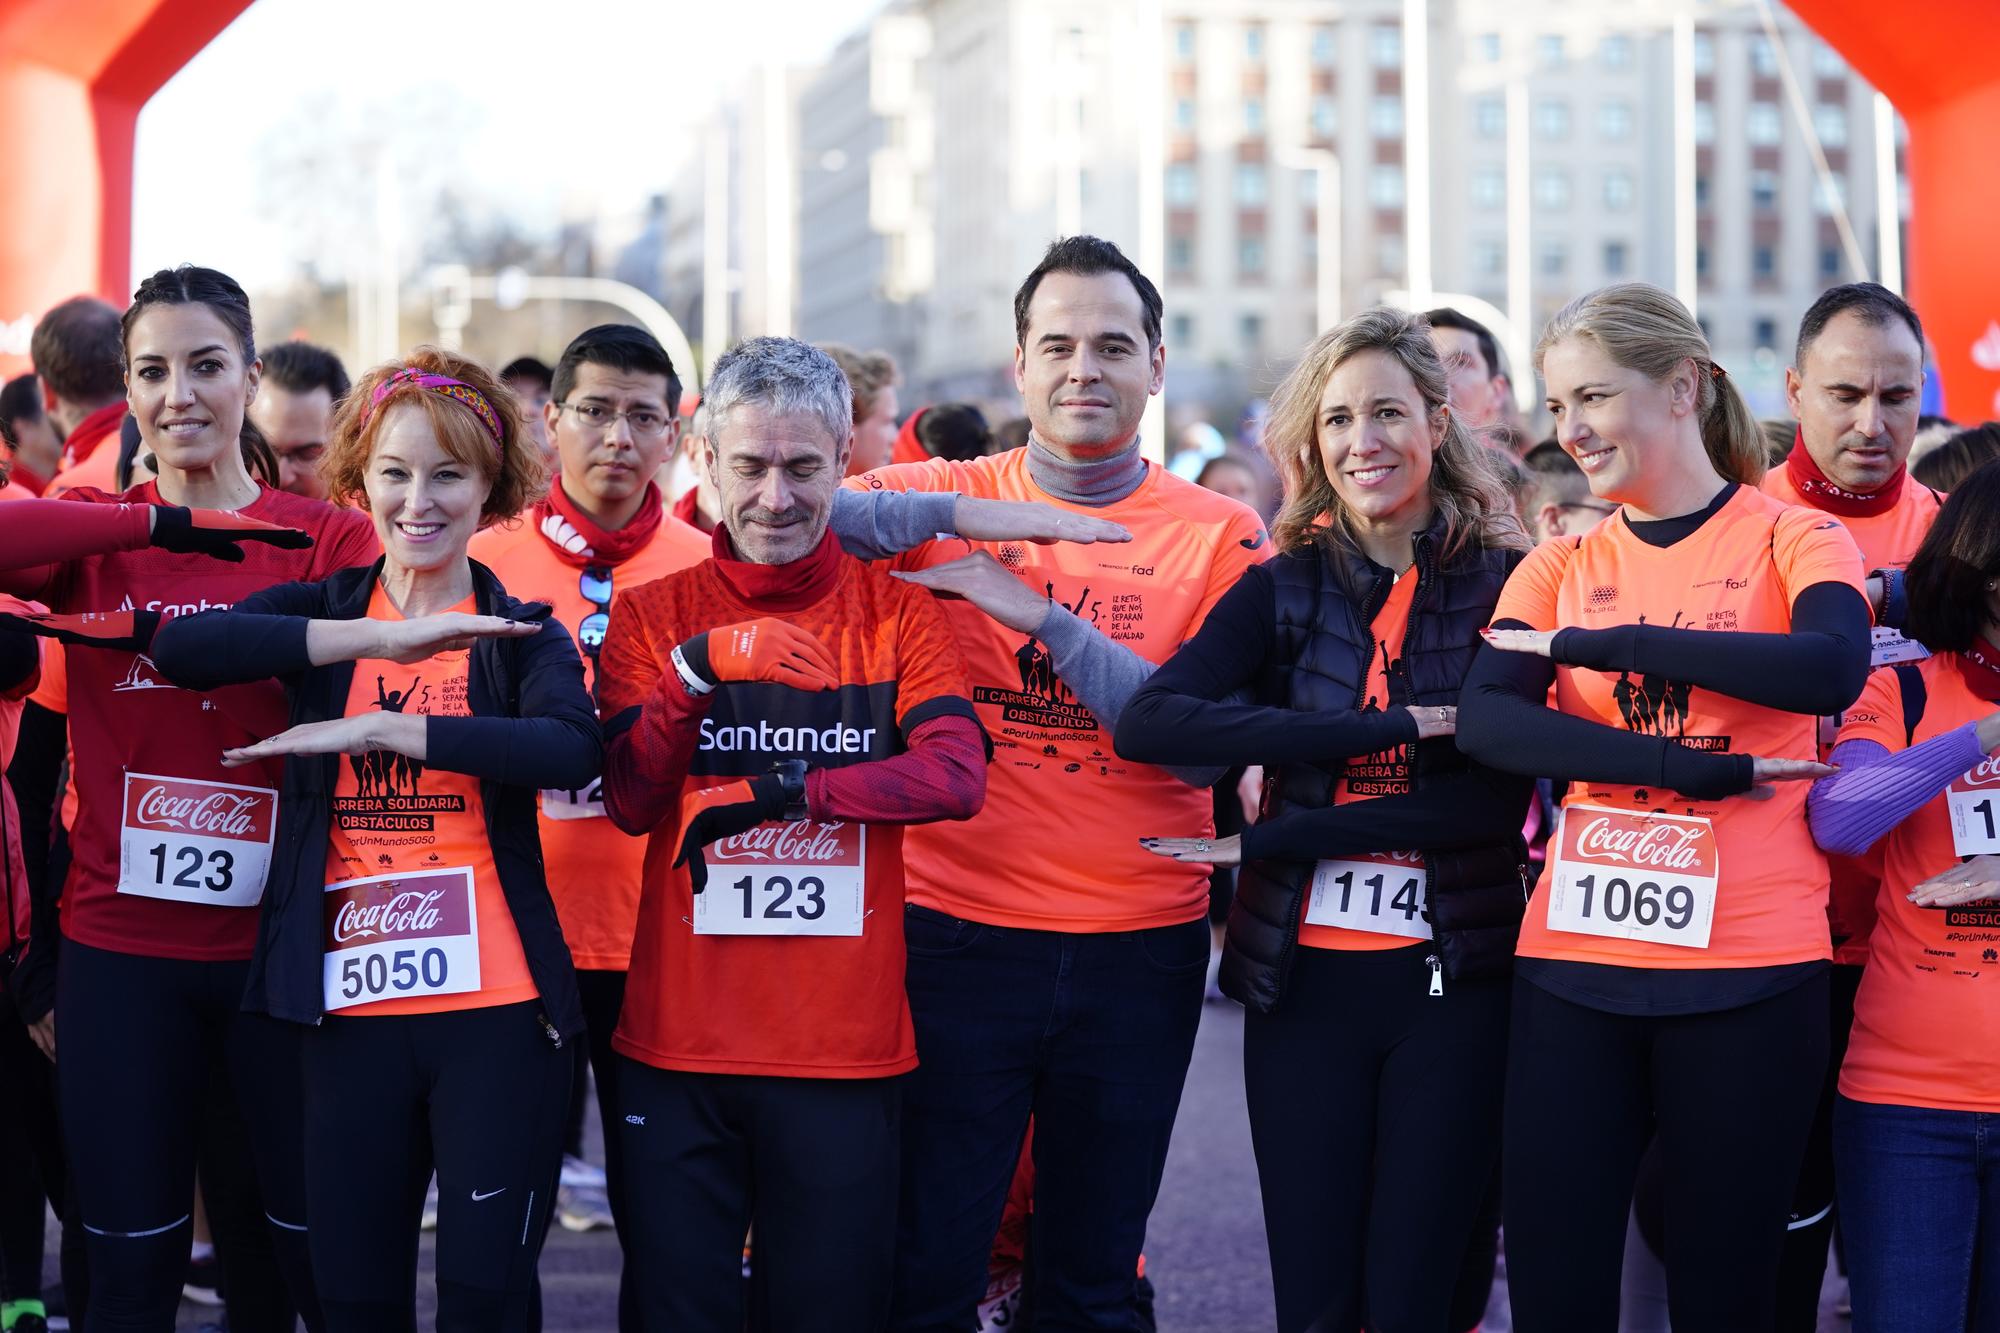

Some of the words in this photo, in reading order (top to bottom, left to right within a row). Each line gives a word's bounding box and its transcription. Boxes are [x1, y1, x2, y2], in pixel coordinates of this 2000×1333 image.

[1132, 565, 1155, 576] fad
[1726, 577, 1748, 590] fad
[1112, 594, 1120, 603] 12
[1120, 594, 1142, 603] RETOS
[1111, 603, 1127, 613] QUE
[1128, 603, 1143, 613] NOS
[1111, 612, 1144, 623] SEPARAN
[1706, 612, 1714, 621] 12
[1714, 609, 1737, 620] RETOS
[1111, 622, 1122, 631] DE
[1122, 622, 1132, 631] LA
[1706, 622, 1721, 631] QUE
[1723, 619, 1738, 630] NOS
[1111, 631, 1145, 641] IGUALDAD
[450, 675, 469, 686] RETO
[442, 685, 457, 695] QUE
[458, 684, 469, 694] NO
[442, 693, 469, 703] SEPARA
[976, 689, 985, 700] II
[989, 690, 1048, 709] CARRERA
[1051, 703, 1096, 719] SOLID
[442, 703, 452, 711] DE
[453, 702, 464, 711] LA
[1008, 709, 1094, 728] OBSTÁCULOS
[699, 718, 877, 753] Santander
[1001, 727, 1099, 742] #PorUnMundo5050
[993, 740, 1018, 749] APFRE
[136, 785, 262, 835] Coca-Cola
[387, 797, 461, 811] SOLIDARIA
[341, 814, 430, 830] OBSTÁCULOS
[1576, 816, 1707, 870] Coca-Cola
[149, 842, 235, 892] 123
[733, 875, 826, 921] 123
[1575, 873, 1695, 931] 1069
[333, 887, 445, 943] Coca-Cola
[341, 946, 448, 1000] 5050
[625, 1114, 646, 1126] 42K
